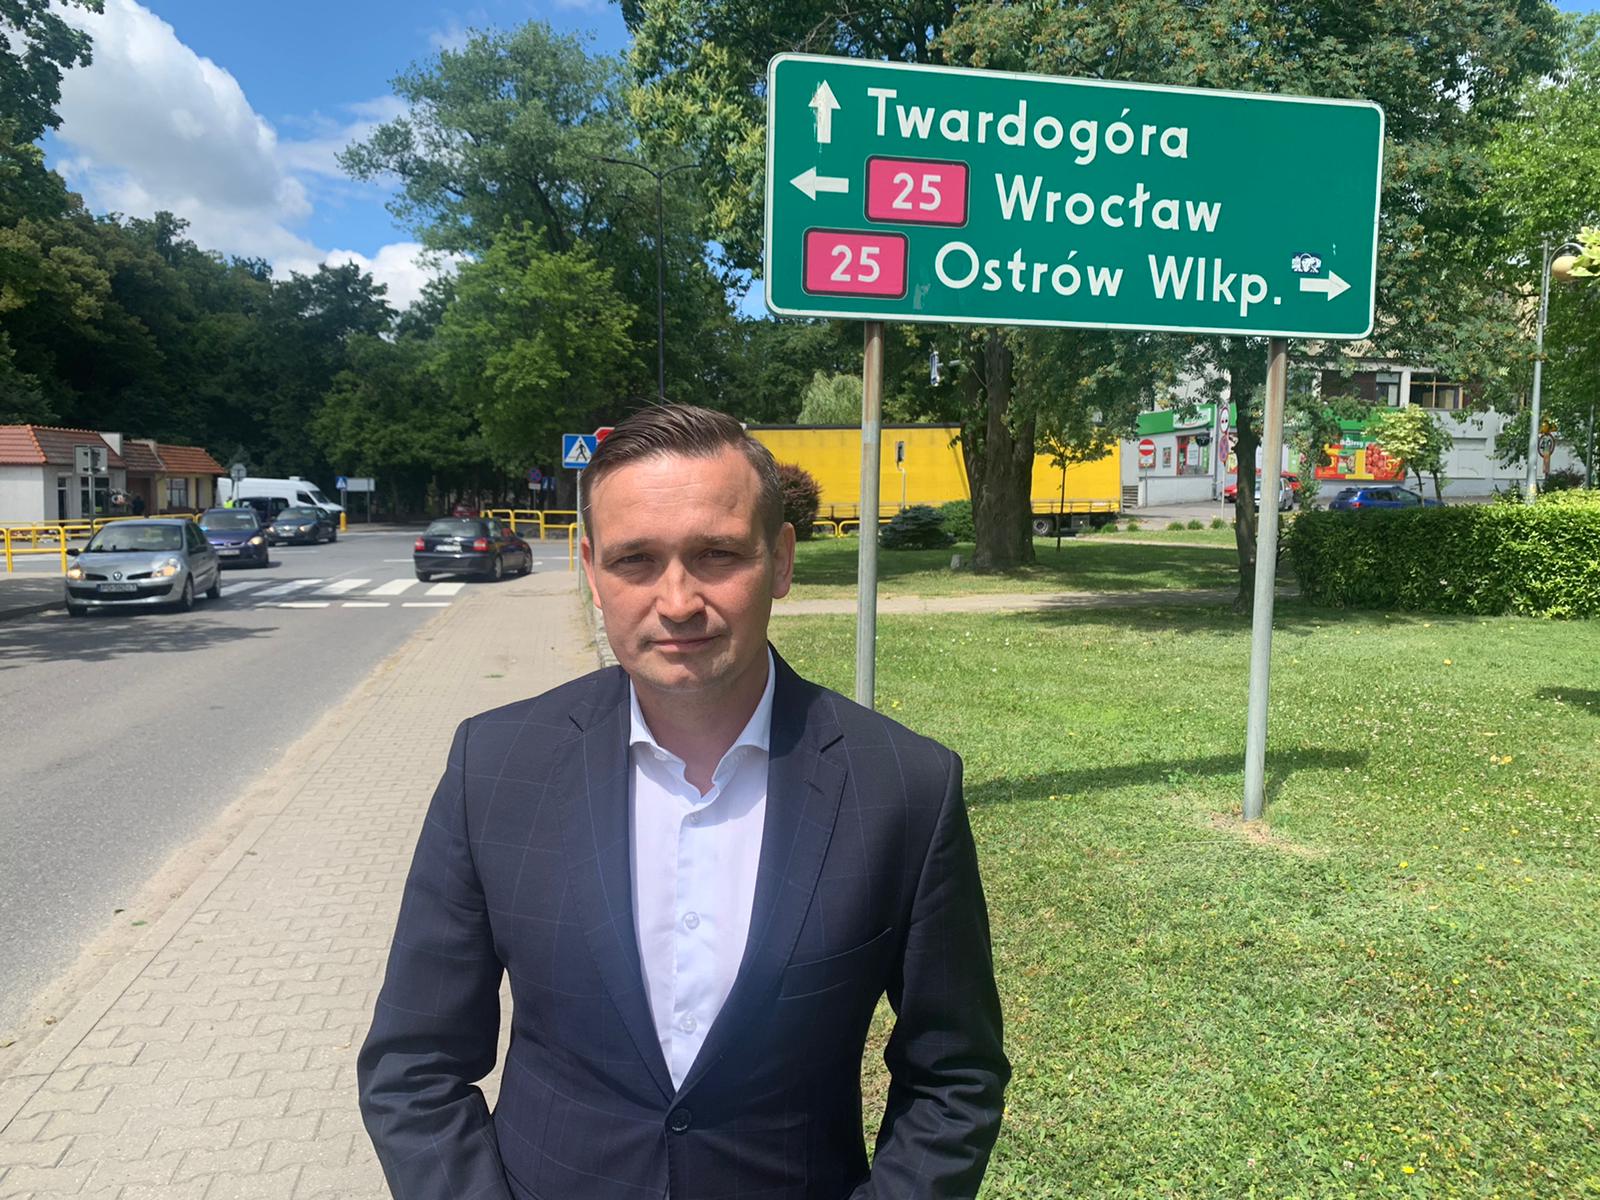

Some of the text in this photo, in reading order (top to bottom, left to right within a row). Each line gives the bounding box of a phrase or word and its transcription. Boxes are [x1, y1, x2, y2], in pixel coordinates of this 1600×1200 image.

[867, 87, 1190, 166] Twardogóra
[891, 172, 1222, 233] 25 Wrocław
[830, 241, 1283, 318] 25 Ostrów Wlkp.
